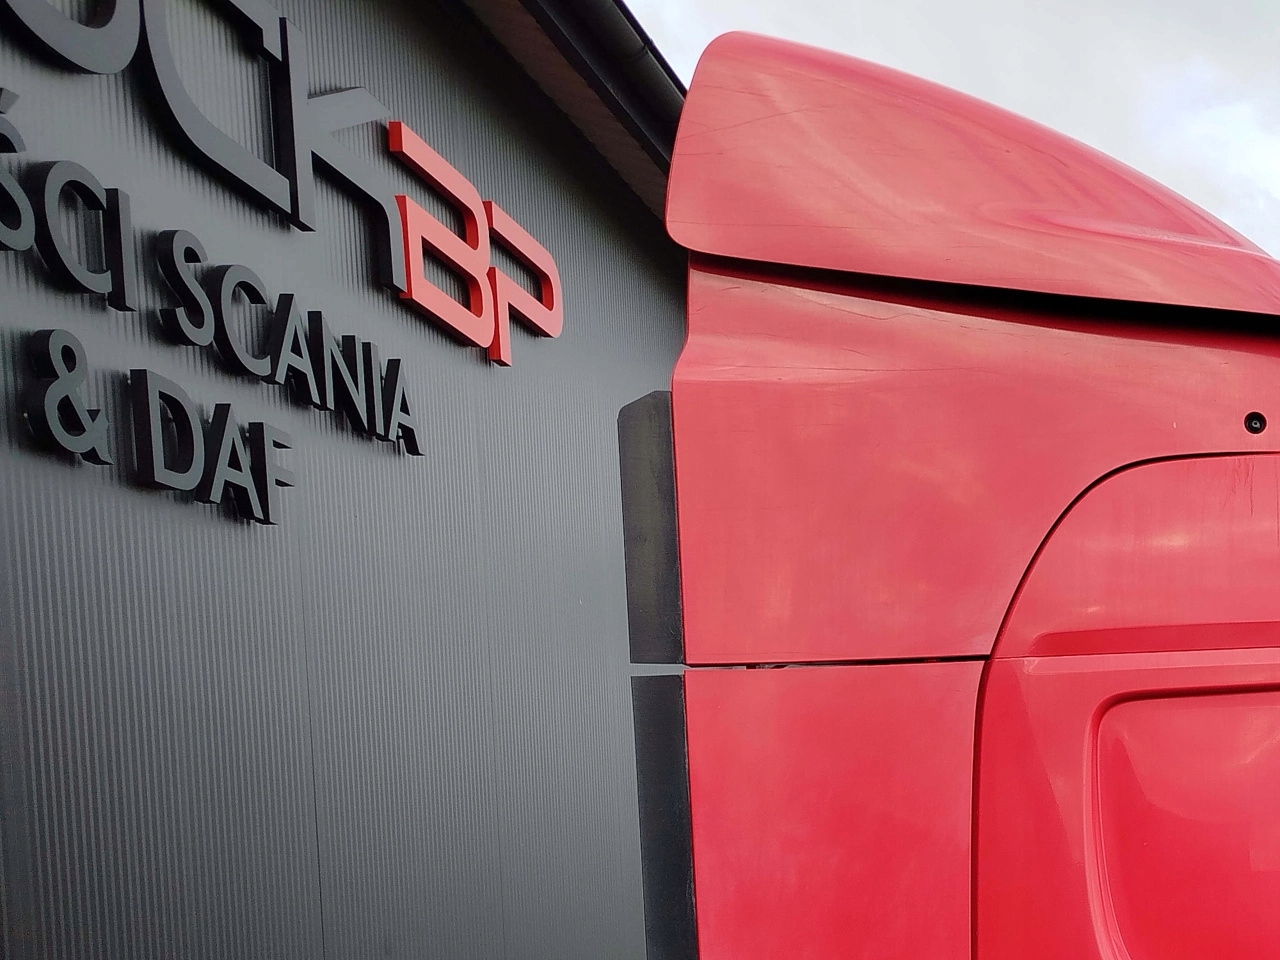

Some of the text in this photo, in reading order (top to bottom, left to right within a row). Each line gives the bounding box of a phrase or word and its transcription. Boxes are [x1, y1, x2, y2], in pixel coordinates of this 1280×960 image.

[28, 329, 296, 525] & DAF
[159, 229, 424, 456] SCANIA
